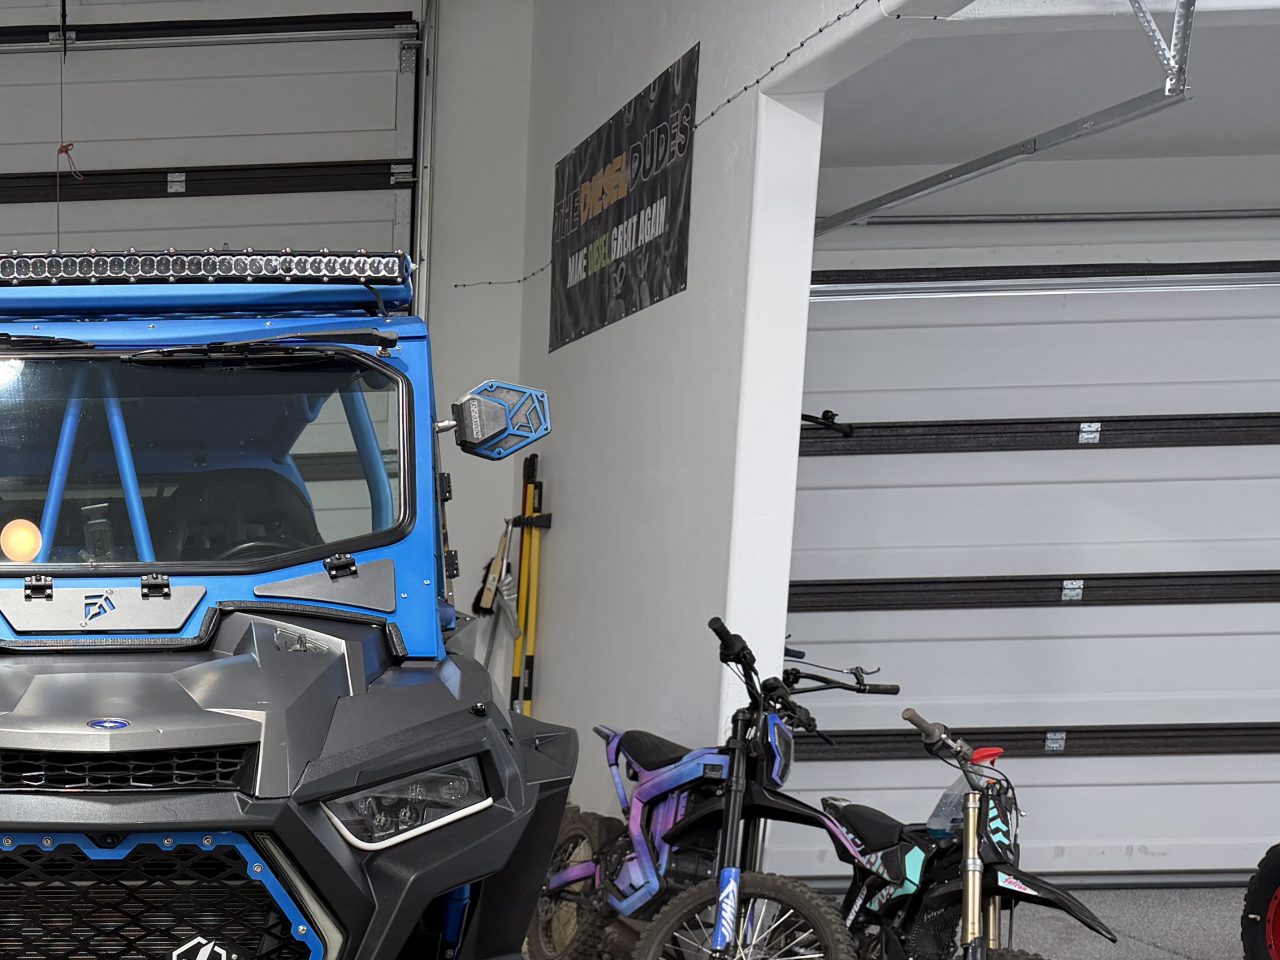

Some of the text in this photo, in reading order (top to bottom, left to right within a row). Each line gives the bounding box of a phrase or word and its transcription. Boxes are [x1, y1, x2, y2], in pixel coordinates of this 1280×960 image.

[630, 103, 691, 192] DUDES
[611, 213, 638, 261] GREAT
[638, 196, 666, 247] AGAIN
